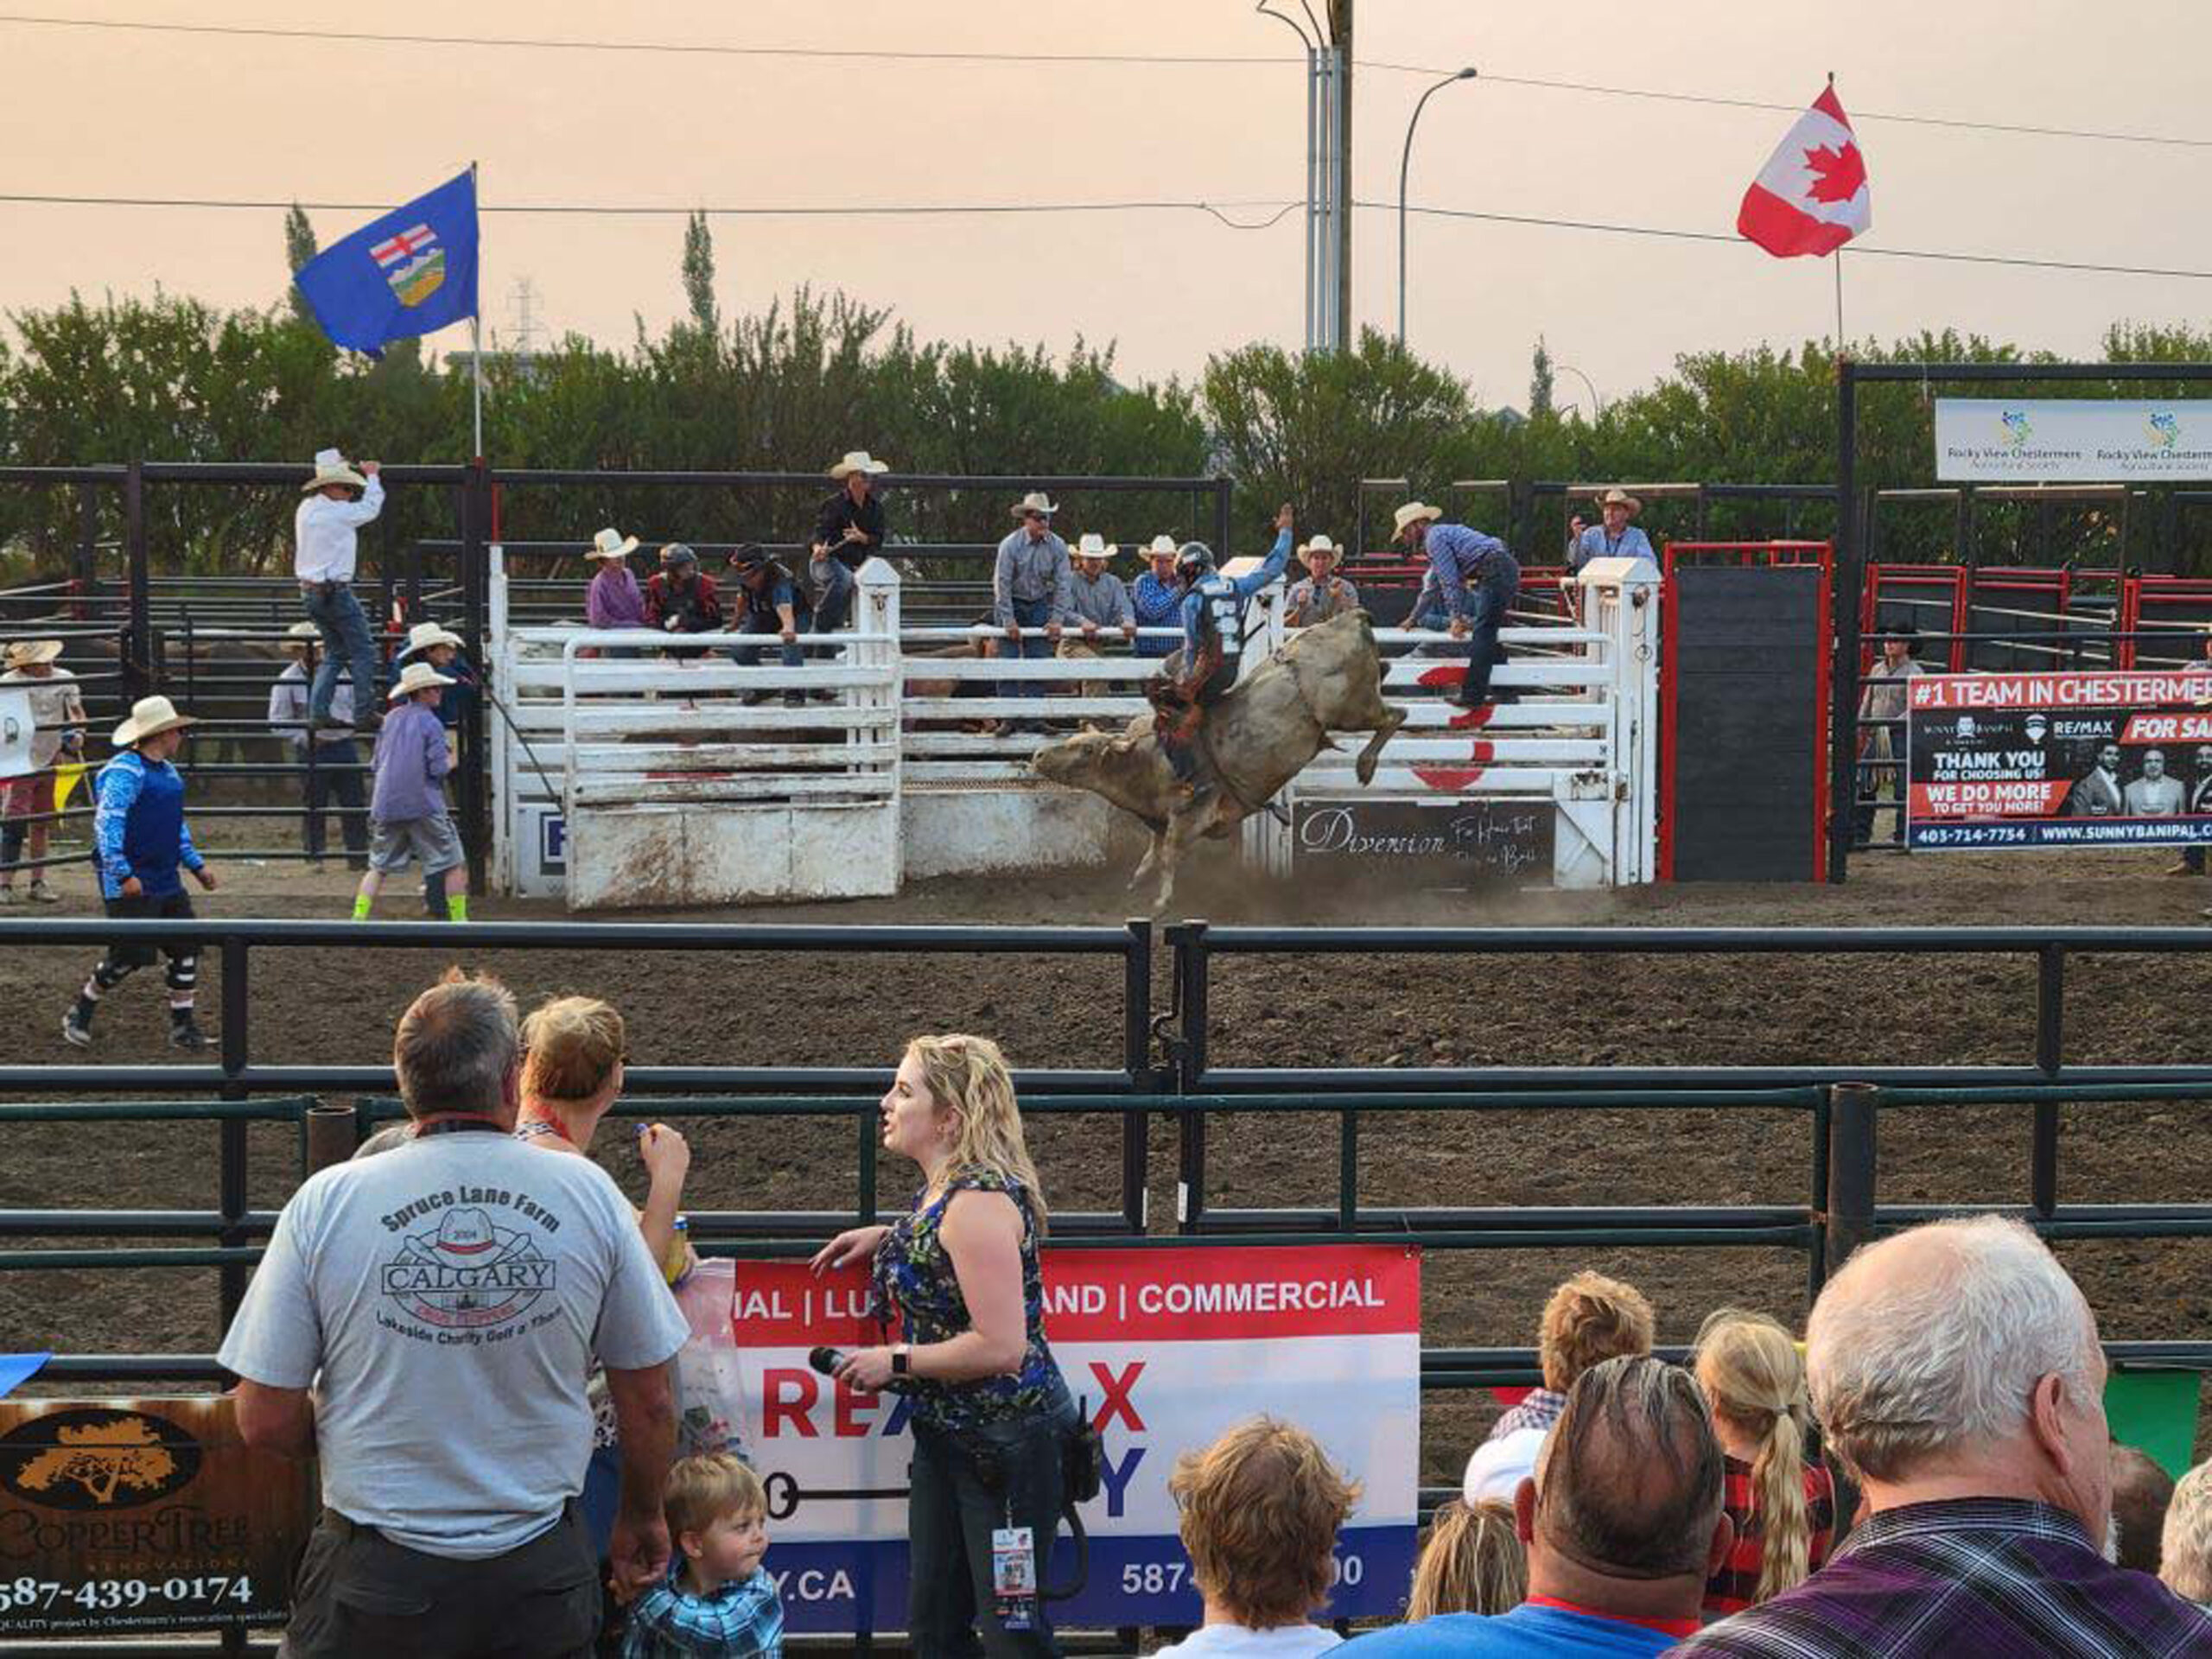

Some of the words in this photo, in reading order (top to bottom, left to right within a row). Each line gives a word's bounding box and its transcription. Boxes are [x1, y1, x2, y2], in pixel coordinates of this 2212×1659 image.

[1948, 447, 1980, 460] Rocky
[1983, 447, 2009, 458] View
[2012, 447, 2082, 458] Chestermere
[2097, 448, 2129, 461] Rocky
[2131, 448, 2158, 460] View
[2161, 448, 2212, 460] Chesterm
[1915, 682, 1948, 706] #1
[1951, 680, 2023, 705] TEAM
[2029, 679, 2054, 704] IN
[2053, 720, 2113, 734] RE/MAX
[2130, 718, 2177, 739] FOR
[1933, 752, 2002, 769] THANK
[2005, 750, 2046, 767] YOU
[1933, 770, 1958, 781] FOR
[1961, 768, 2022, 780] CHOOSING
[2024, 767, 2046, 779] US!
[1927, 784, 1956, 803] WE
[1961, 783, 1991, 802] DO
[1995, 782, 2052, 800] MORE
[1932, 802, 1949, 814] TO
[1951, 802, 1974, 814] GET
[1977, 801, 2003, 814] YOU
[2005, 800, 2044, 813] MORE!
[1917, 827, 2026, 843] 403-714-7754
[380, 1190, 455, 1234] Spruce
[459, 1185, 511, 1205] Lane
[512, 1192, 561, 1234] Farm
[388, 1263, 550, 1290] CALGARY
[734, 1289, 793, 1319] IAL
[1039, 1285, 1106, 1314] AND
[1138, 1278, 1386, 1313] COMMERCIAL
[0, 1575, 253, 1612] 587-439-0174
[772, 1569, 855, 1601] Y.CA
